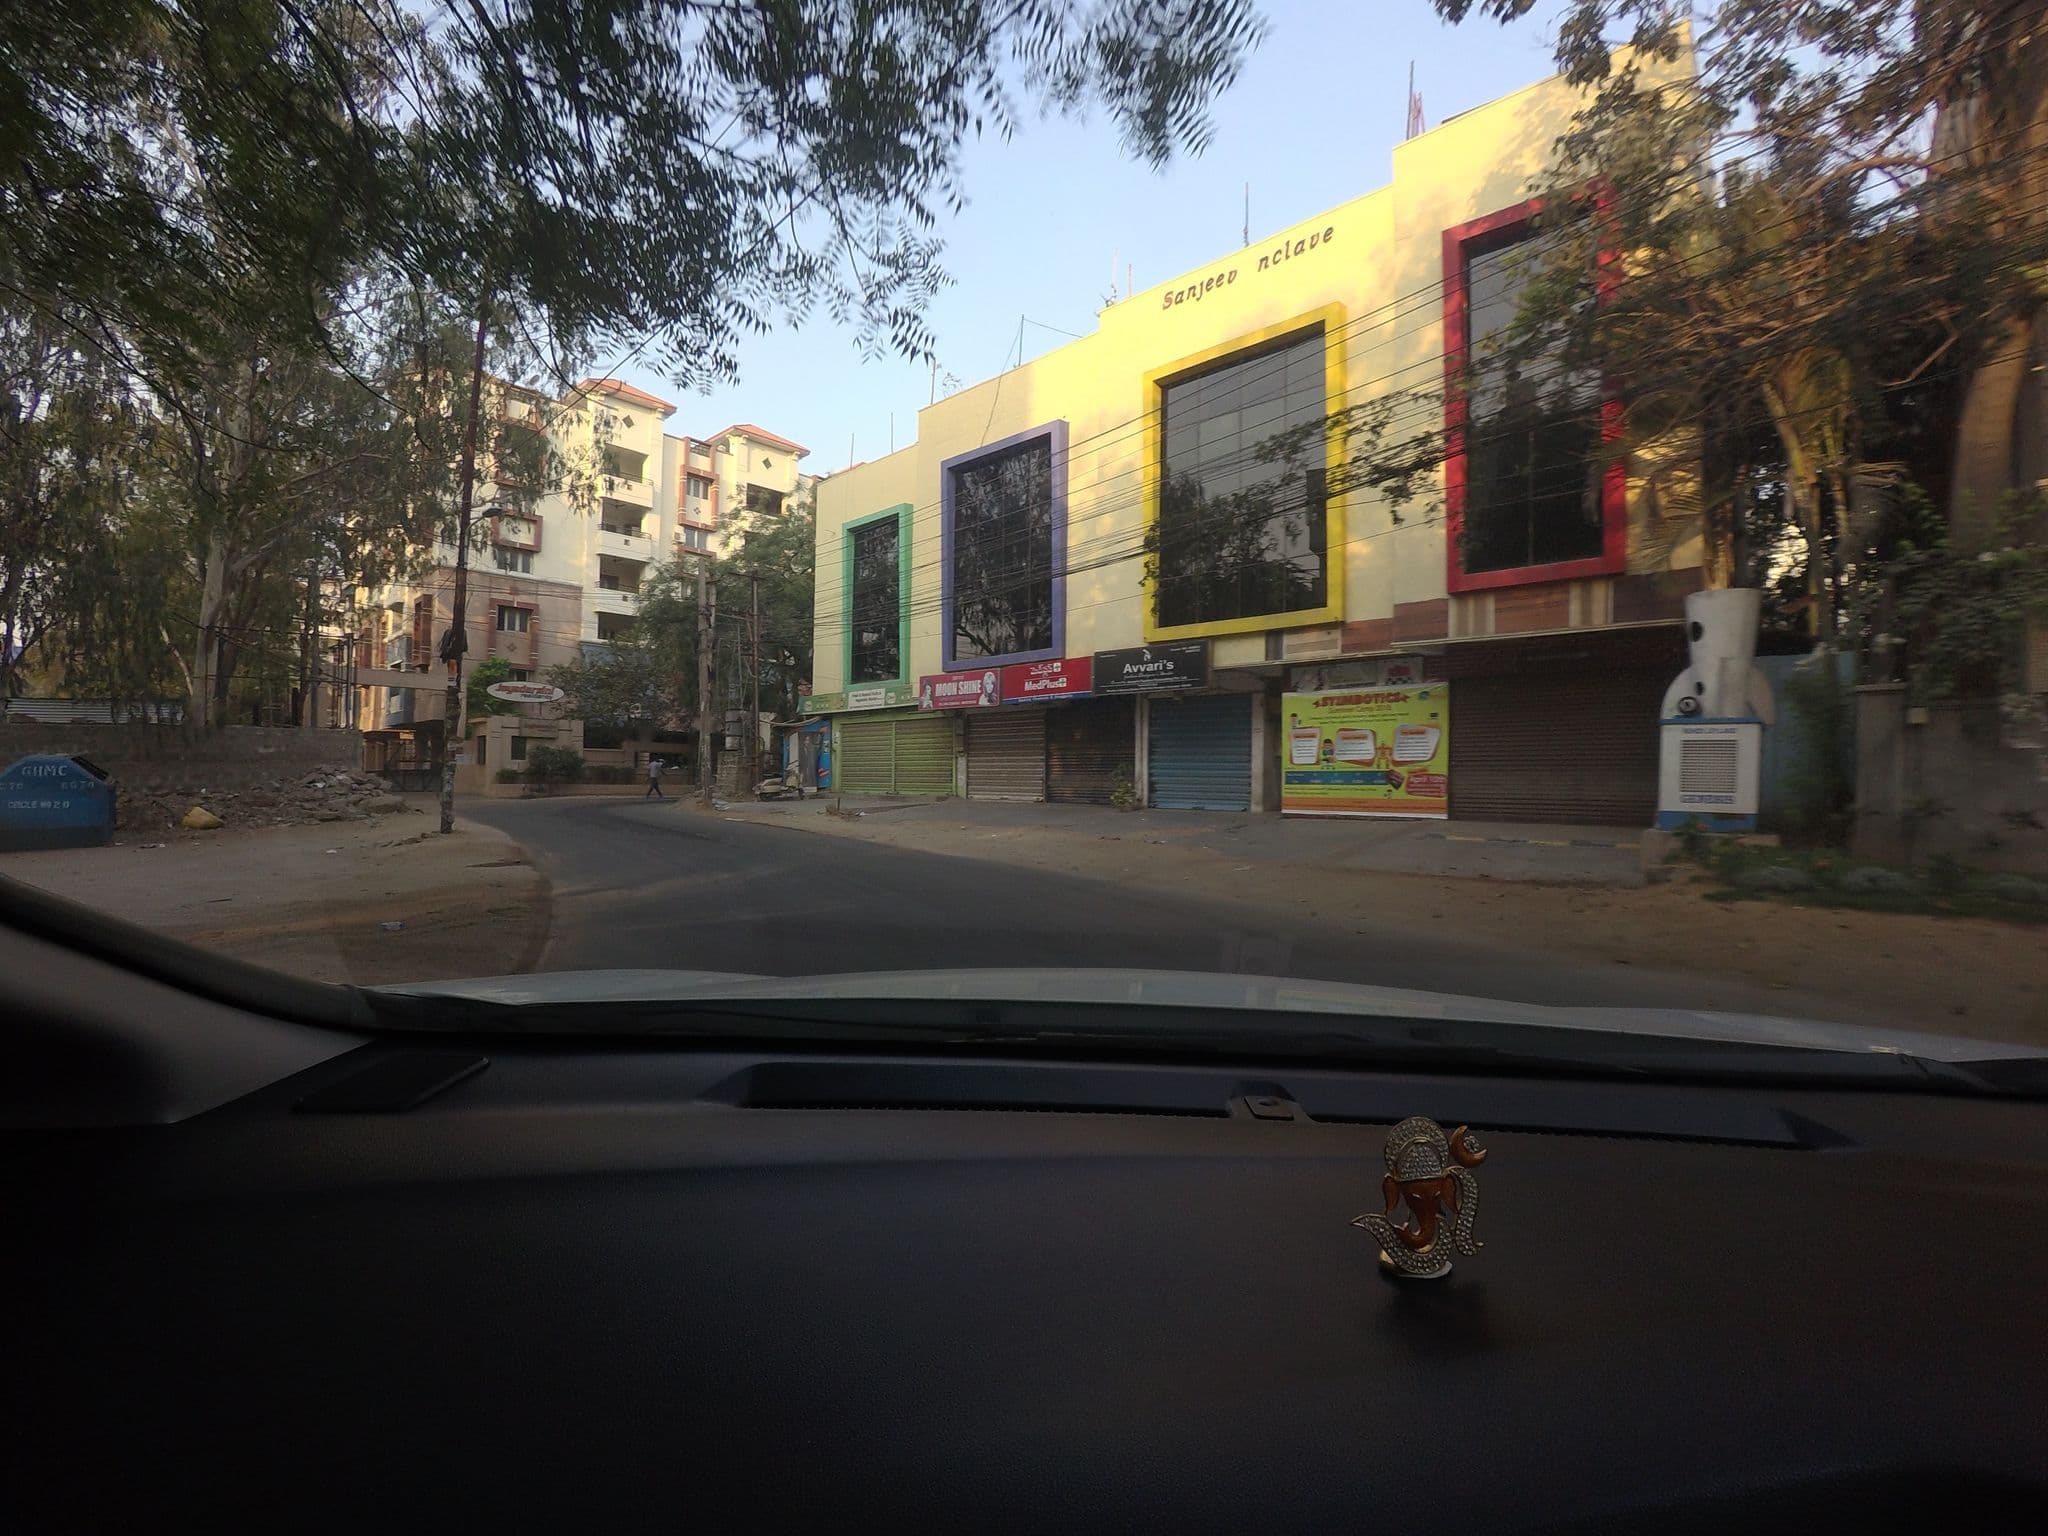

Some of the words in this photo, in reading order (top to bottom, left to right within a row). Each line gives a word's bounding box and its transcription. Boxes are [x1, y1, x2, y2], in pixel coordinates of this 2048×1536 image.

[1162, 269, 1238, 310] Sanjeev
[1257, 226, 1335, 273] nclave
[1123, 660, 1174, 673] Avvari's
[935, 682, 957, 697] MOON
[958, 680, 982, 695] SHINE
[1024, 679, 1061, 692] MedPlus
[22, 765, 68, 777] GHMC
